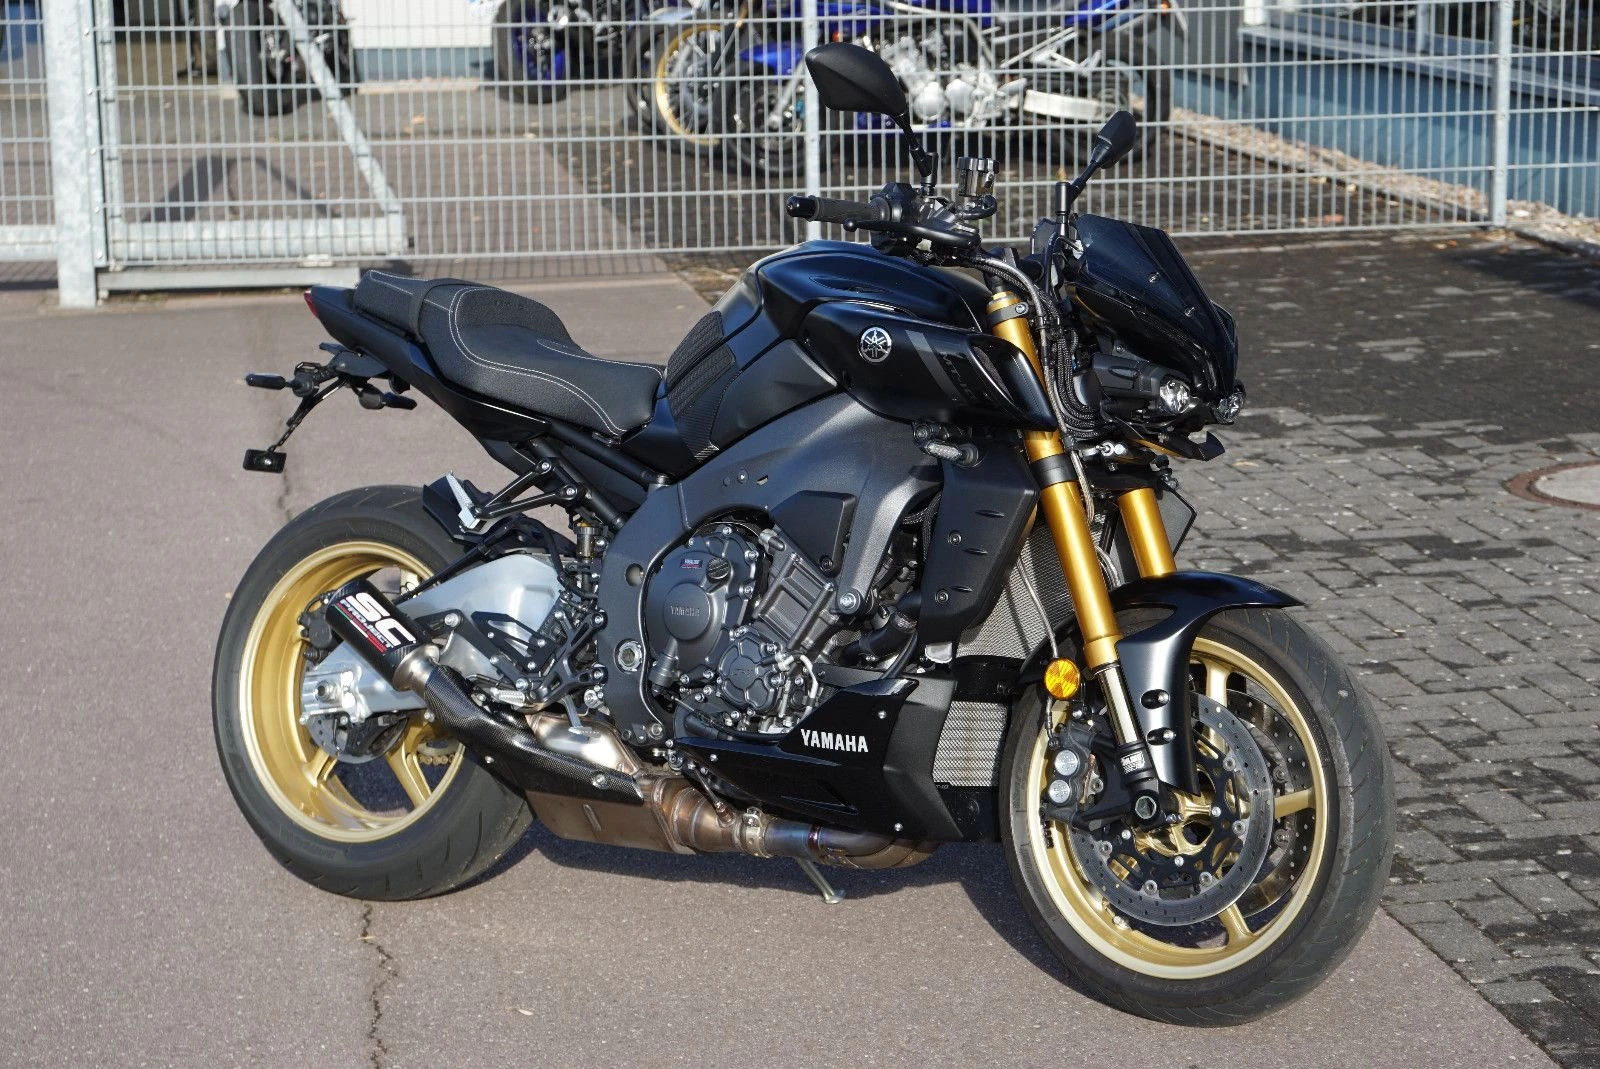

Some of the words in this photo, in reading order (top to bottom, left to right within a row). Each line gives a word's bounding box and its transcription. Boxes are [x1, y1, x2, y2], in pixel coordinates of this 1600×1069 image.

[340, 599, 393, 648] PROJECT
[345, 592, 416, 646] SC
[671, 606, 700, 616] YAMAHA
[801, 729, 868, 753] YAMAHA
